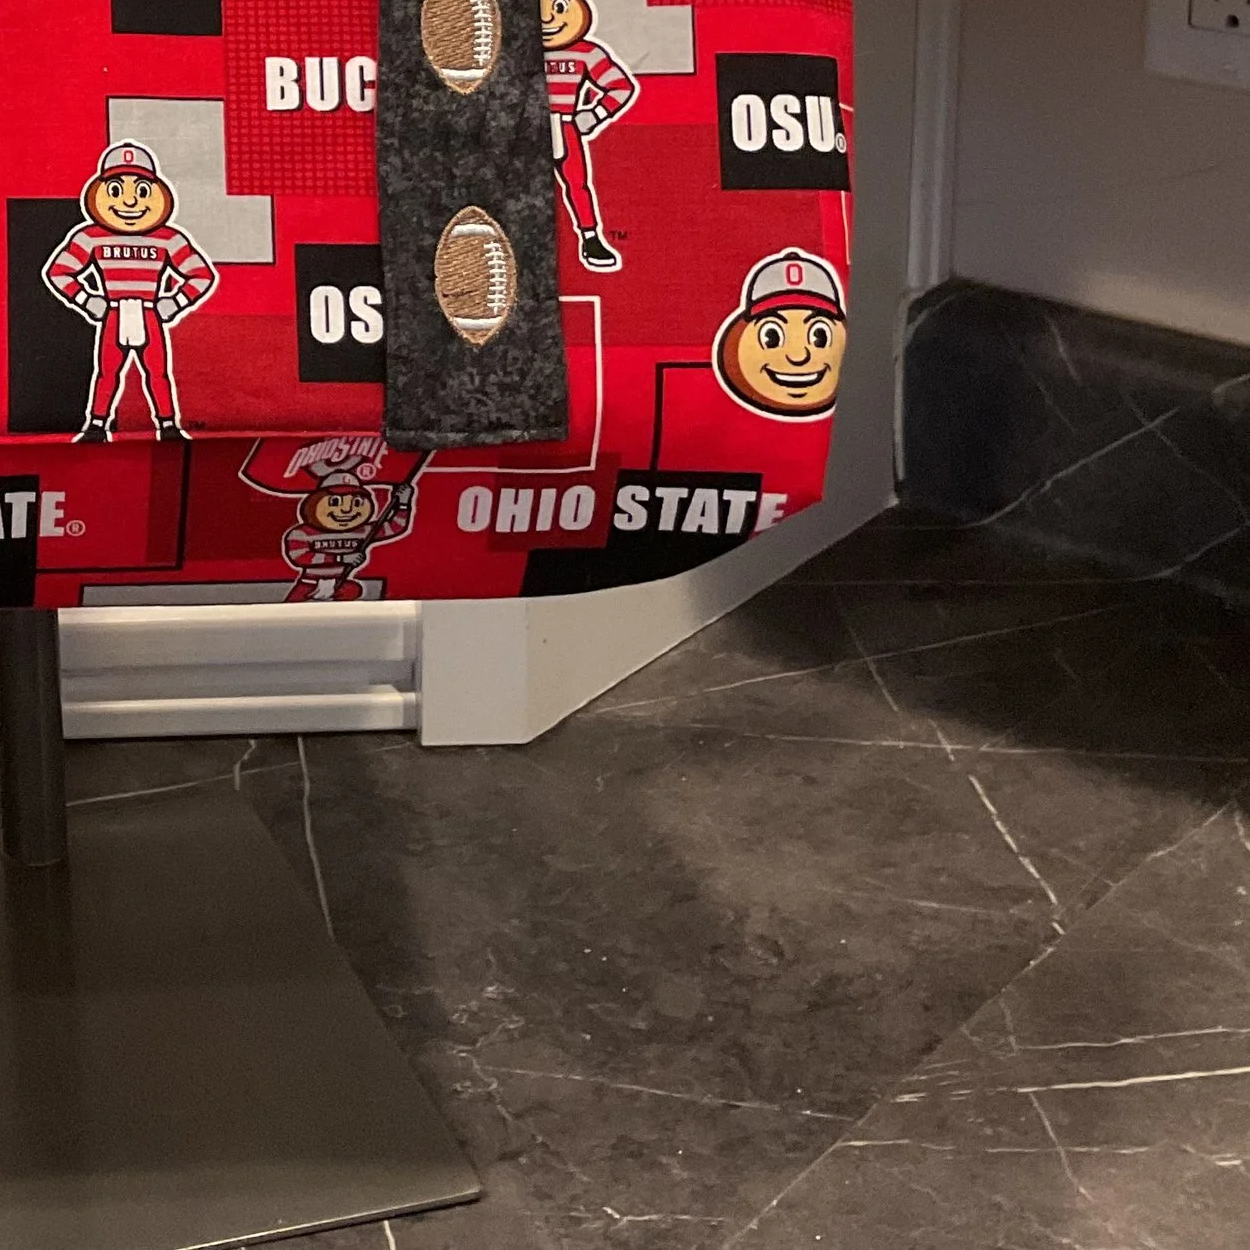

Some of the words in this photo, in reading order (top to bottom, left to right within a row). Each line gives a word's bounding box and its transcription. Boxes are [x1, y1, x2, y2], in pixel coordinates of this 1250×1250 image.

[732, 95, 837, 152] OSU
[103, 246, 157, 258] BRUTUS
[457, 485, 595, 532] OHIO
[614, 485, 787, 534] STATE
